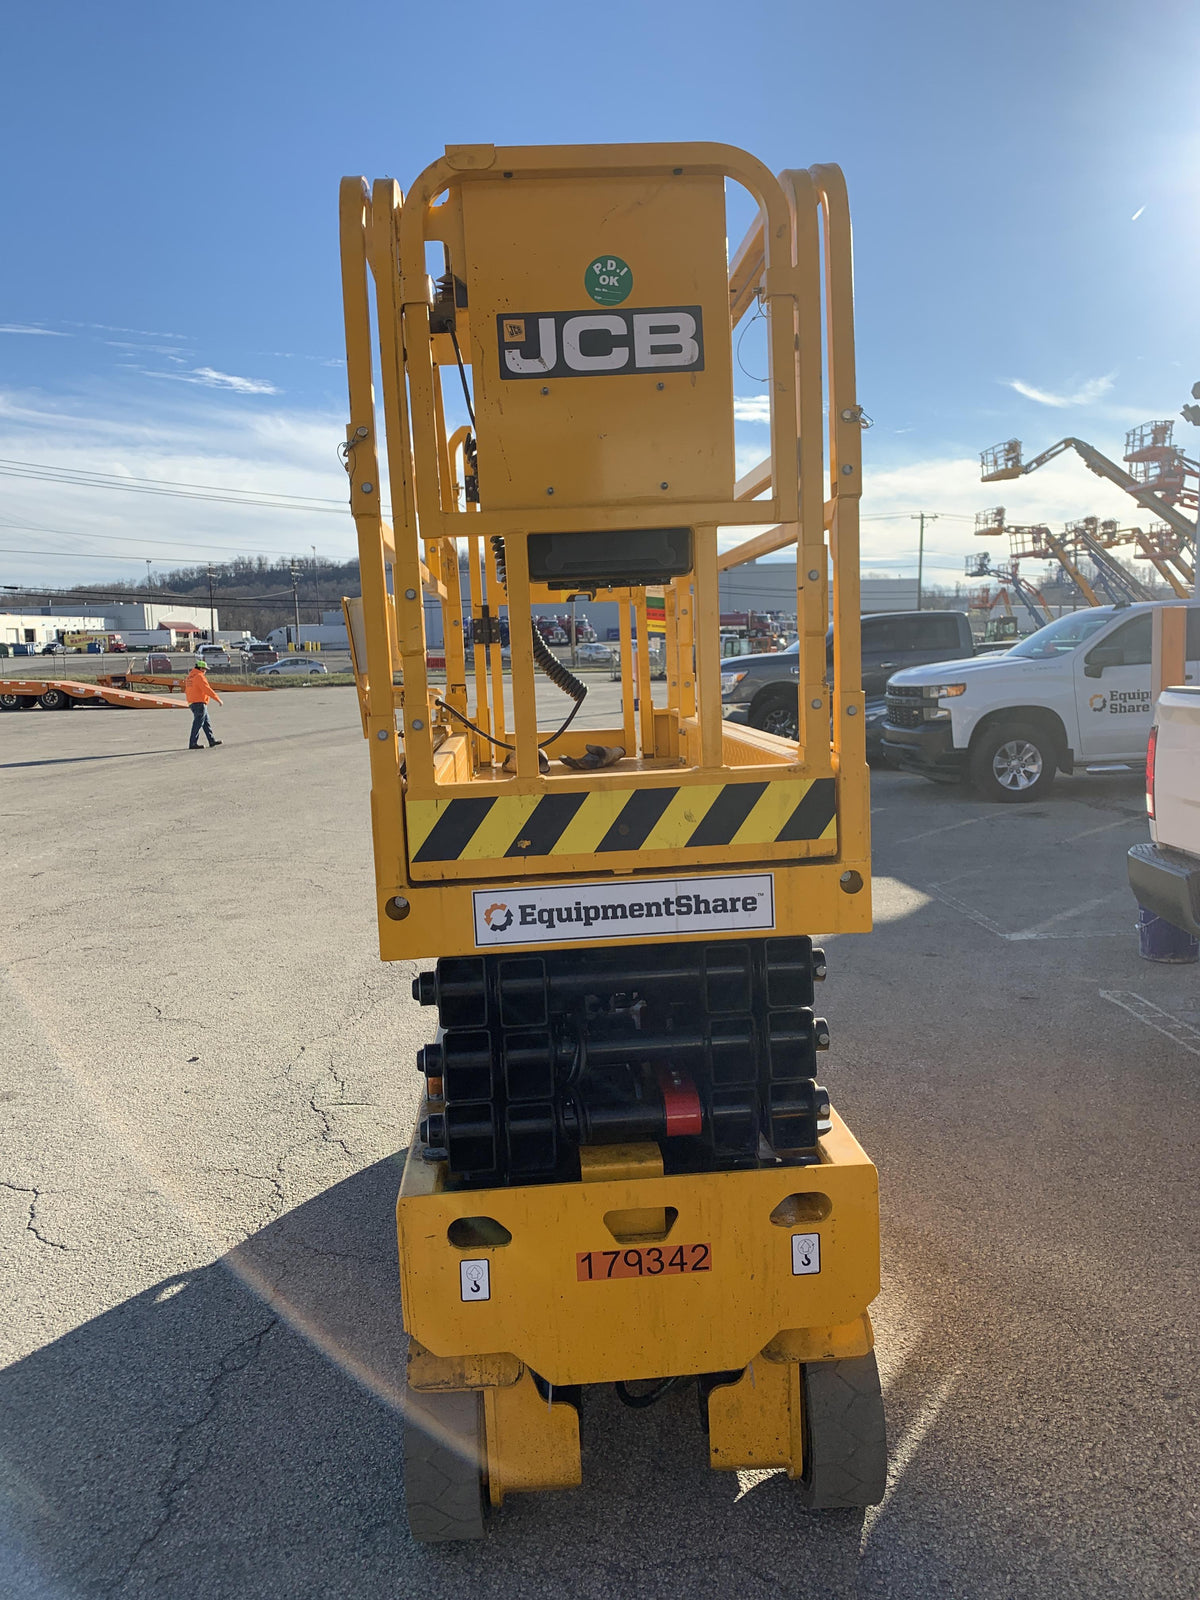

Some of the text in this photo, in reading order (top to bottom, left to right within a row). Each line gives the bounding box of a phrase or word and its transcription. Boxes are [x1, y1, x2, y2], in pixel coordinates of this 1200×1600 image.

[599, 274, 620, 287] OK
[504, 312, 700, 374] JCB
[1109, 703, 1150, 714] Share
[518, 894, 758, 930] EquipmentShare
[580, 1243, 710, 1280] 179342
